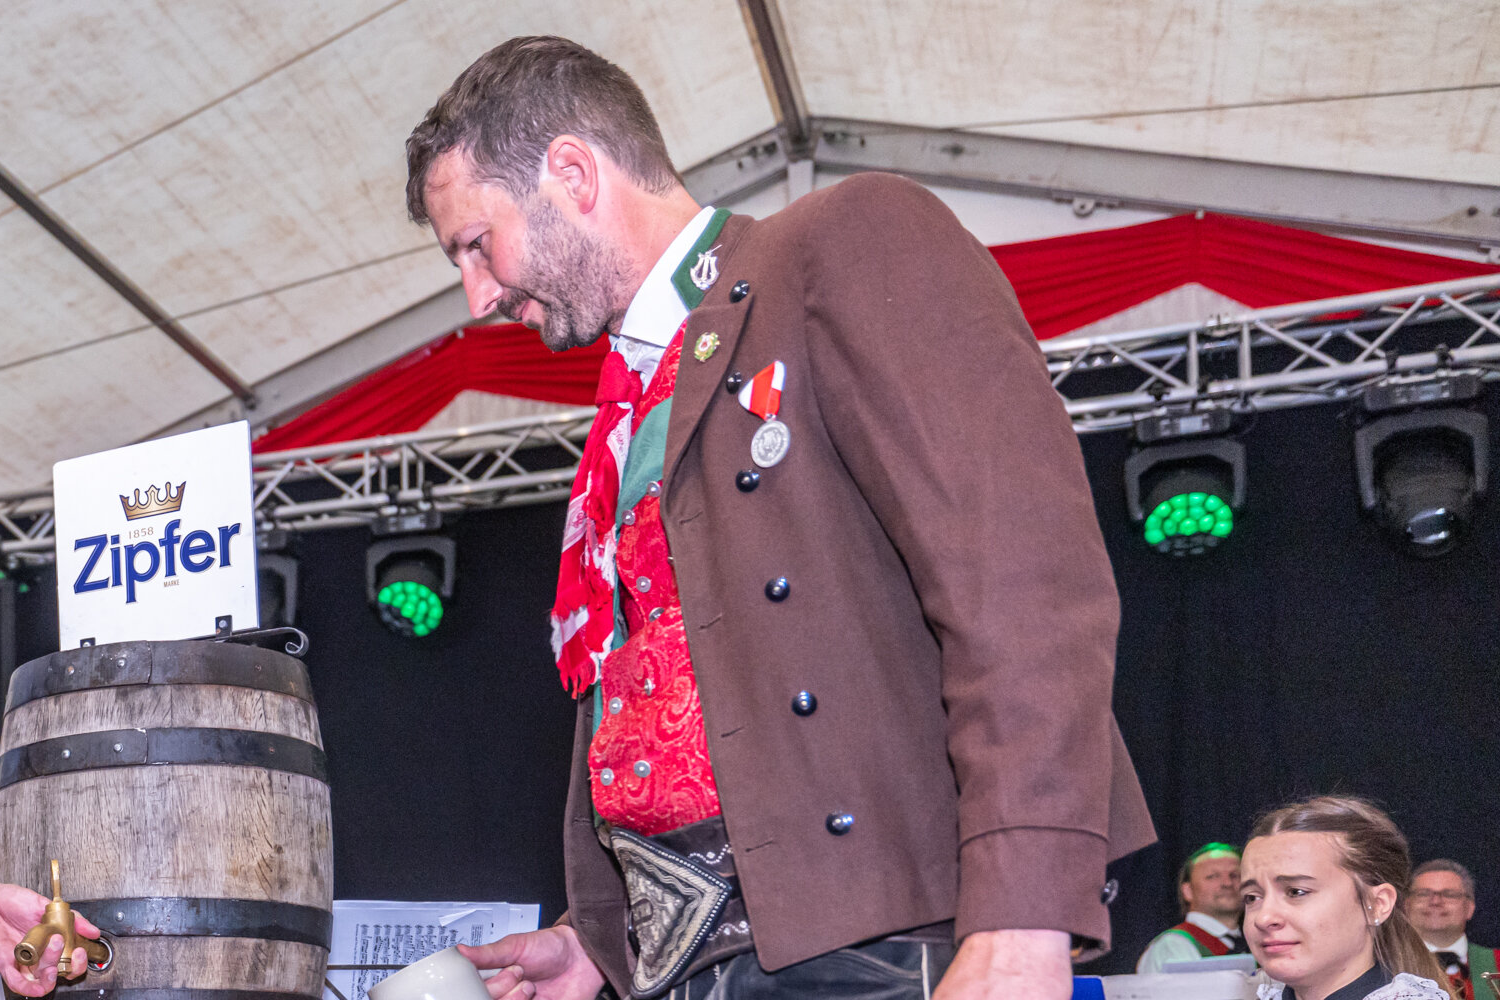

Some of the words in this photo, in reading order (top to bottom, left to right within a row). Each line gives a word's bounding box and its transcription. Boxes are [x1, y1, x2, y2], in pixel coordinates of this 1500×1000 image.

[128, 526, 154, 540] 1858
[73, 518, 241, 604] Zipfer
[163, 579, 180, 588] MARKE
